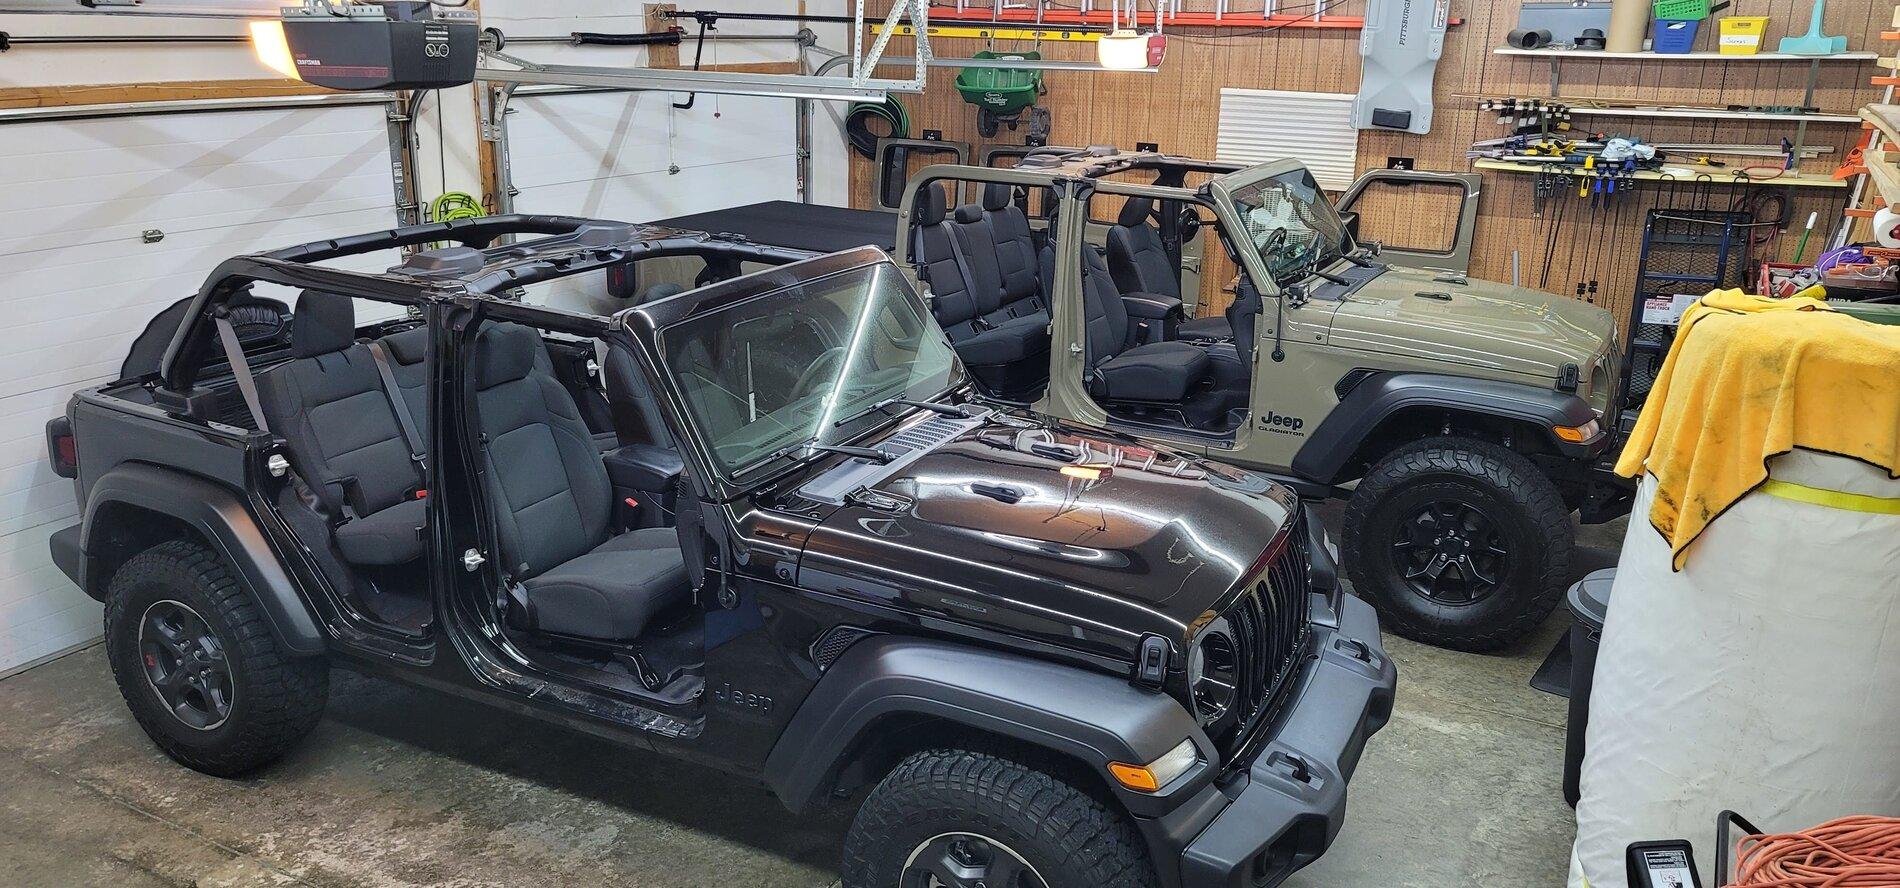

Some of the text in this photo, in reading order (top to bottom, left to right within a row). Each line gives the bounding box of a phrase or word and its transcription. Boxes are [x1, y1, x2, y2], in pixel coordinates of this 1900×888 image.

[1261, 411, 1304, 431] Jeep
[1258, 426, 1305, 437] GLADIATOR
[715, 682, 775, 716] Jeep
